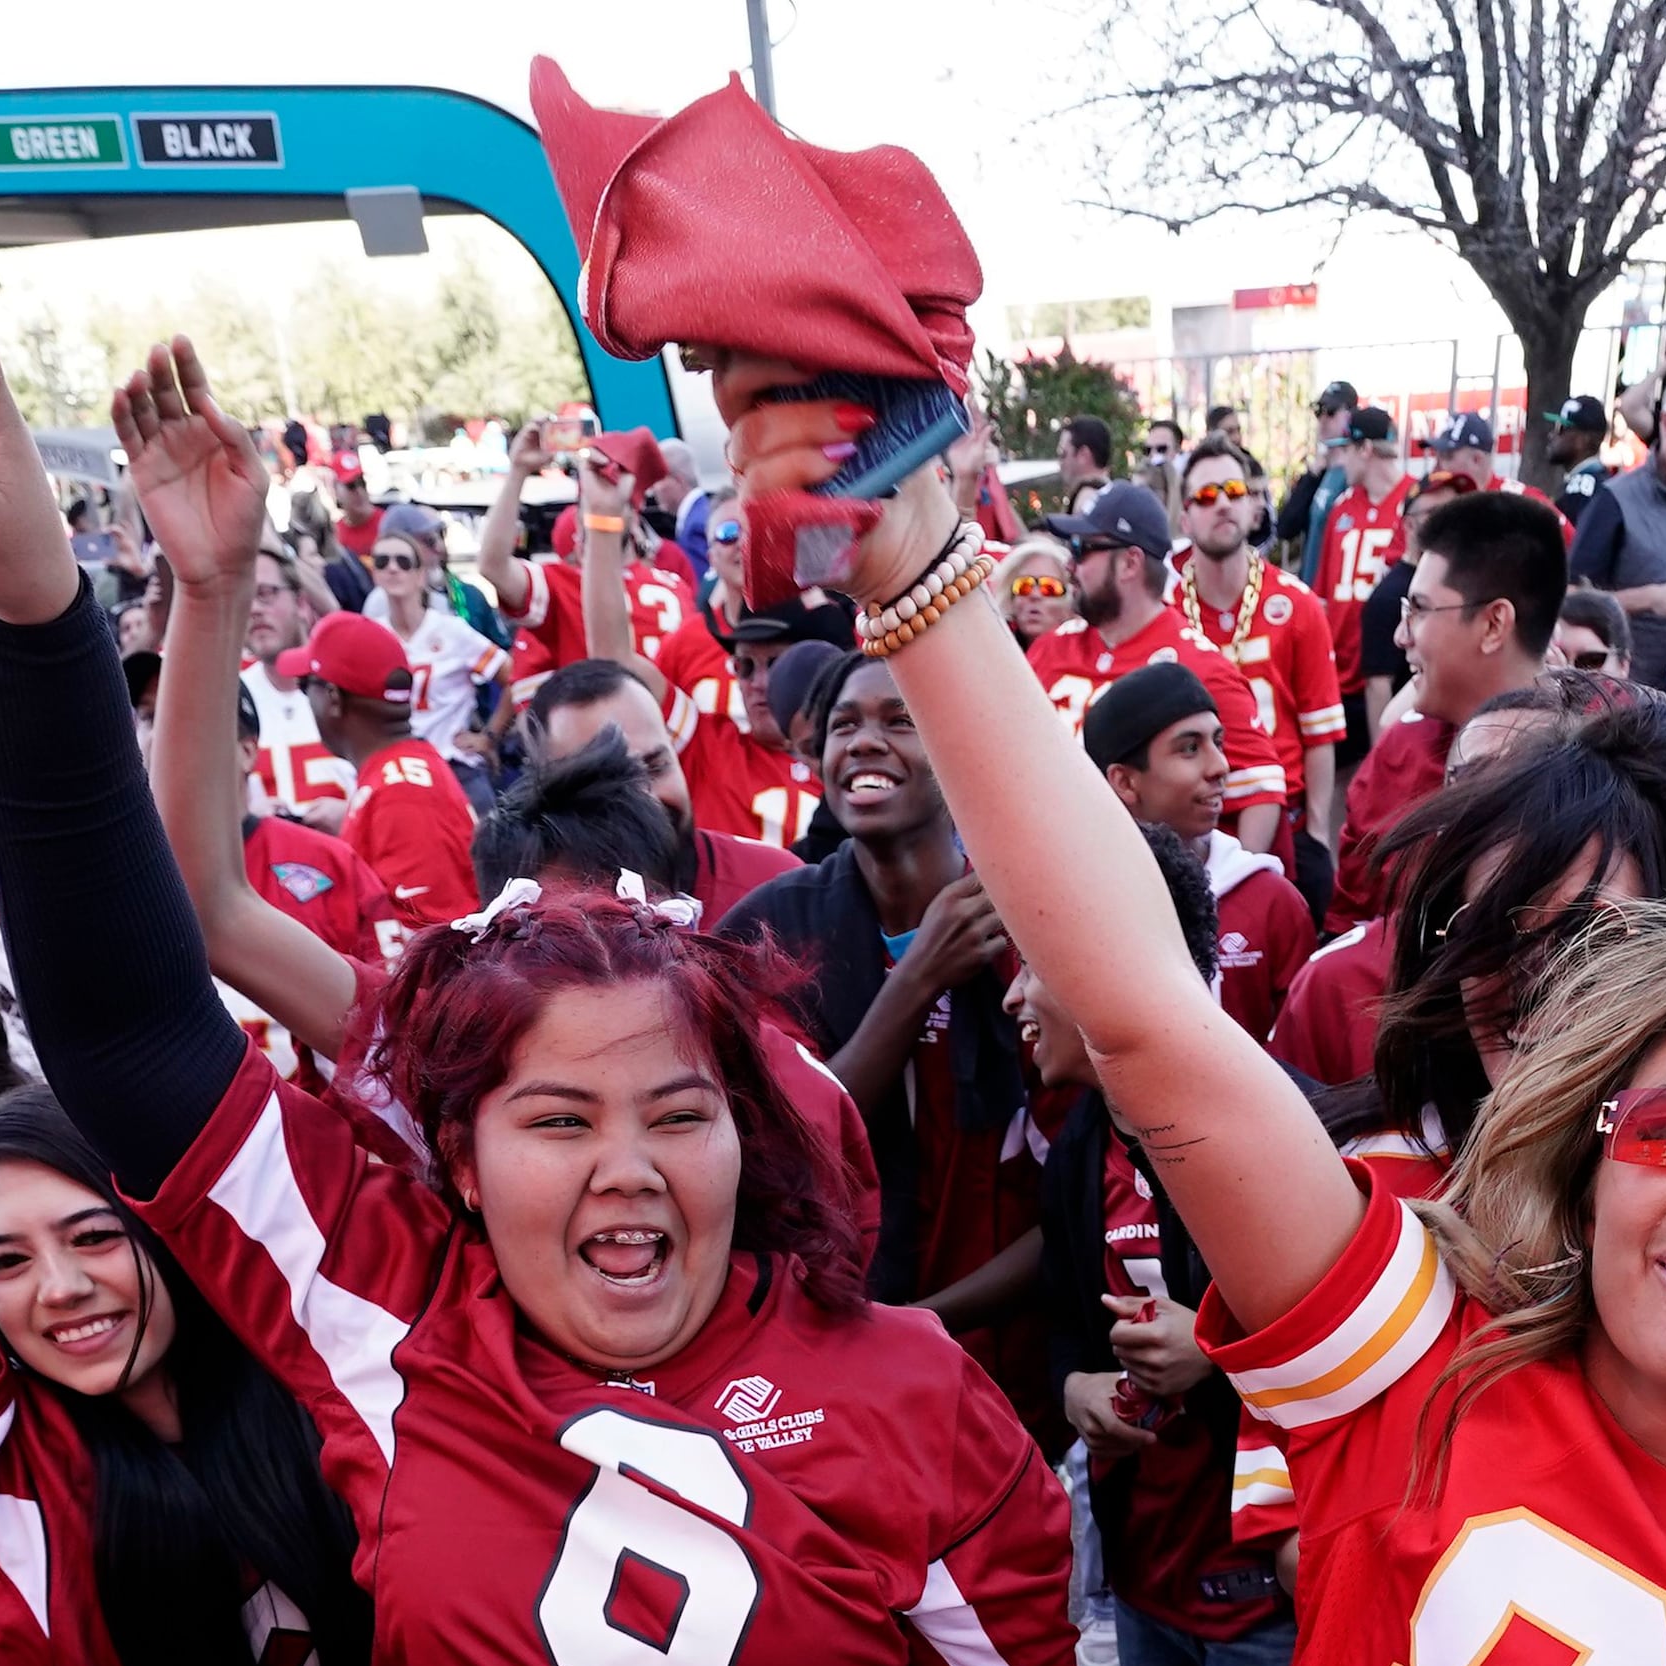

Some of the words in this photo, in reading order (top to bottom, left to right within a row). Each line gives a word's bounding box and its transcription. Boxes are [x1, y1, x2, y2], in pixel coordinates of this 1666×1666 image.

[10, 125, 102, 161] GREEN
[161, 122, 259, 160] BLACK
[381, 756, 433, 788] 15
[1104, 1223, 1160, 1245] CARDIN
[736, 1419, 778, 1440] GIRLS
[777, 1408, 826, 1431] CLUBS
[755, 1426, 814, 1450] VALLEY
